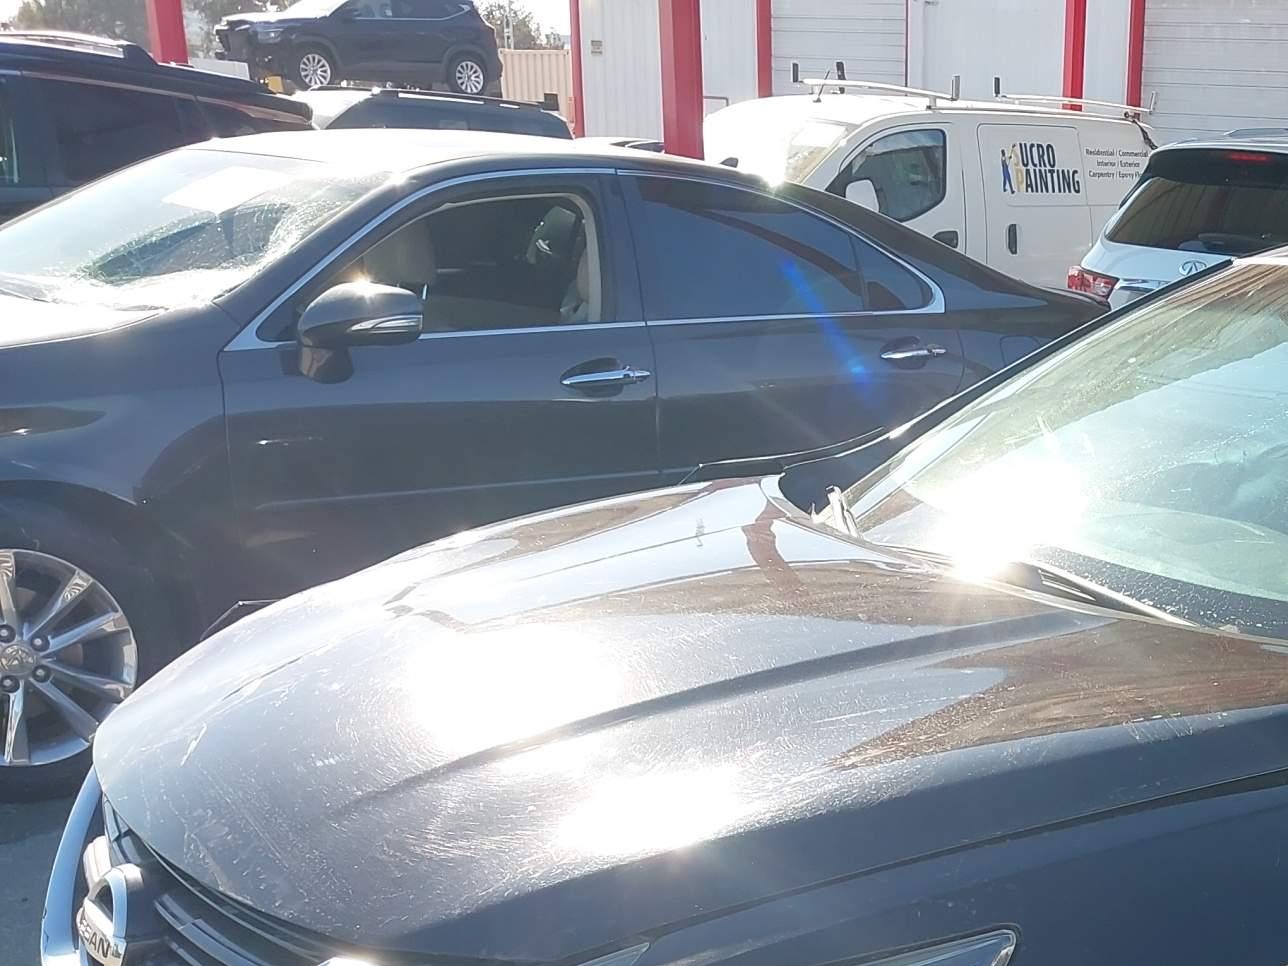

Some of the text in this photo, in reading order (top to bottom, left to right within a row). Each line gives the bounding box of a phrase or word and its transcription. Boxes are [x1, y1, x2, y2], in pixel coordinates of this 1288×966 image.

[1085, 148, 1115, 156] Residential
[1118, 149, 1148, 157] Commercial
[1096, 159, 1115, 167] Interior
[1088, 170, 1114, 179] Carpentry
[1015, 168, 1080, 193] PAINTING
